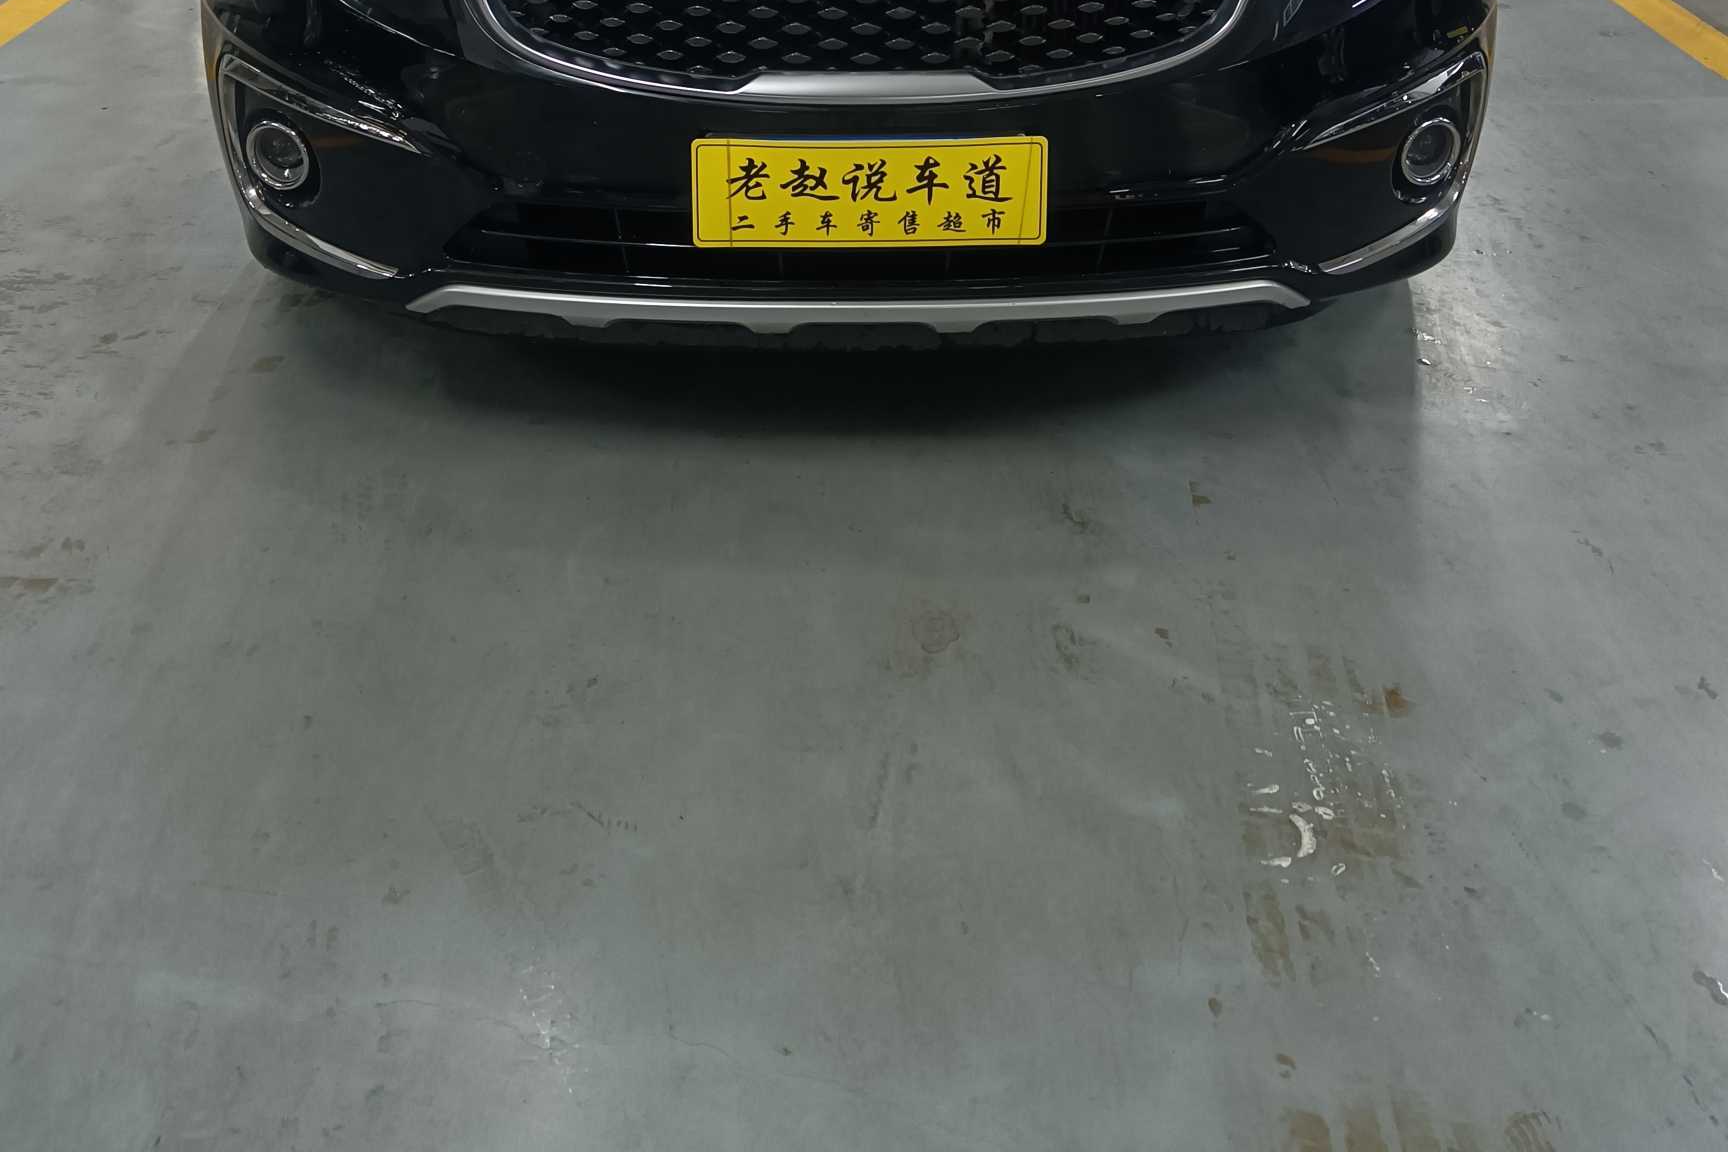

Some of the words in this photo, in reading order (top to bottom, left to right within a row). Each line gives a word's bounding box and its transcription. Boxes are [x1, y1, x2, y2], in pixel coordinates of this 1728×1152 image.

[727, 154, 1012, 205] 老赵说车道
[731, 209, 1006, 236] 二手车寄售超市
